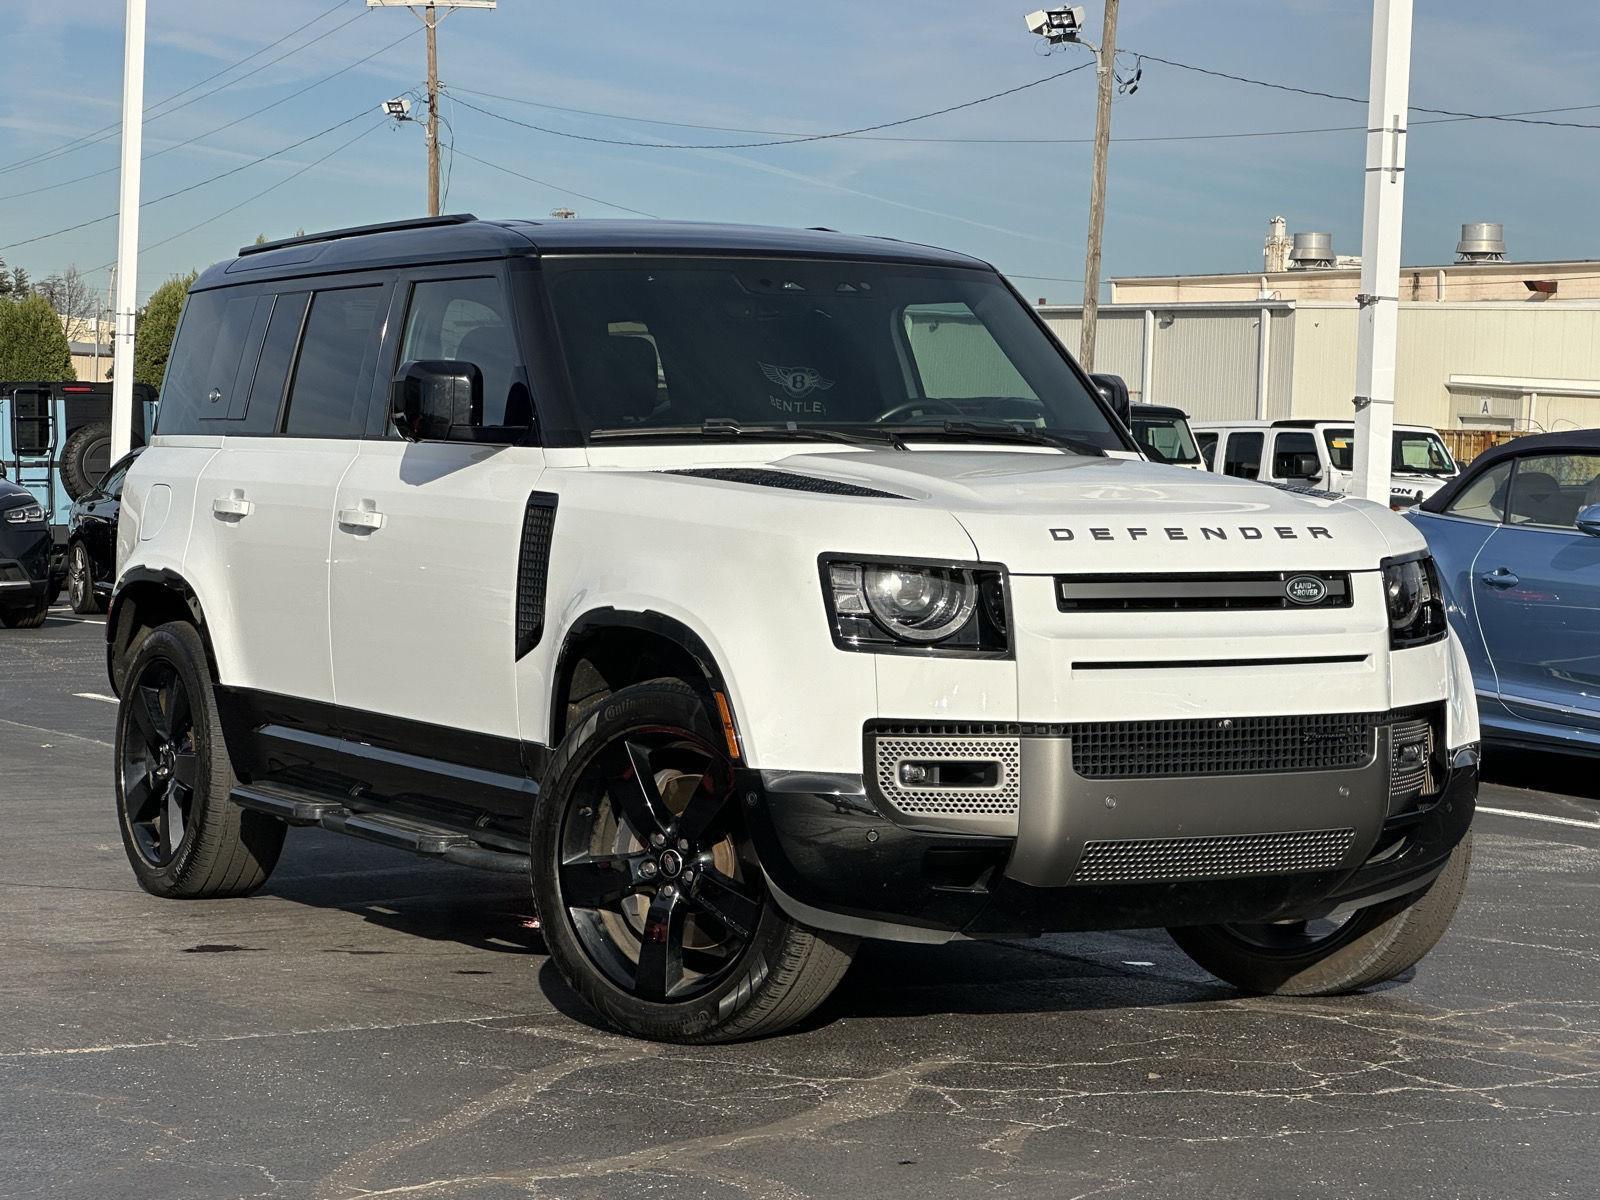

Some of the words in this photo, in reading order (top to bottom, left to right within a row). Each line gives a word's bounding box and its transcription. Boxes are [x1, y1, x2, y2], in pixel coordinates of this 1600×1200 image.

[1481, 400, 1489, 414] A
[1048, 526, 1334, 542] DEFENDER
[1294, 582, 1312, 590] LAND
[1296, 588, 1318, 597] ROVER
